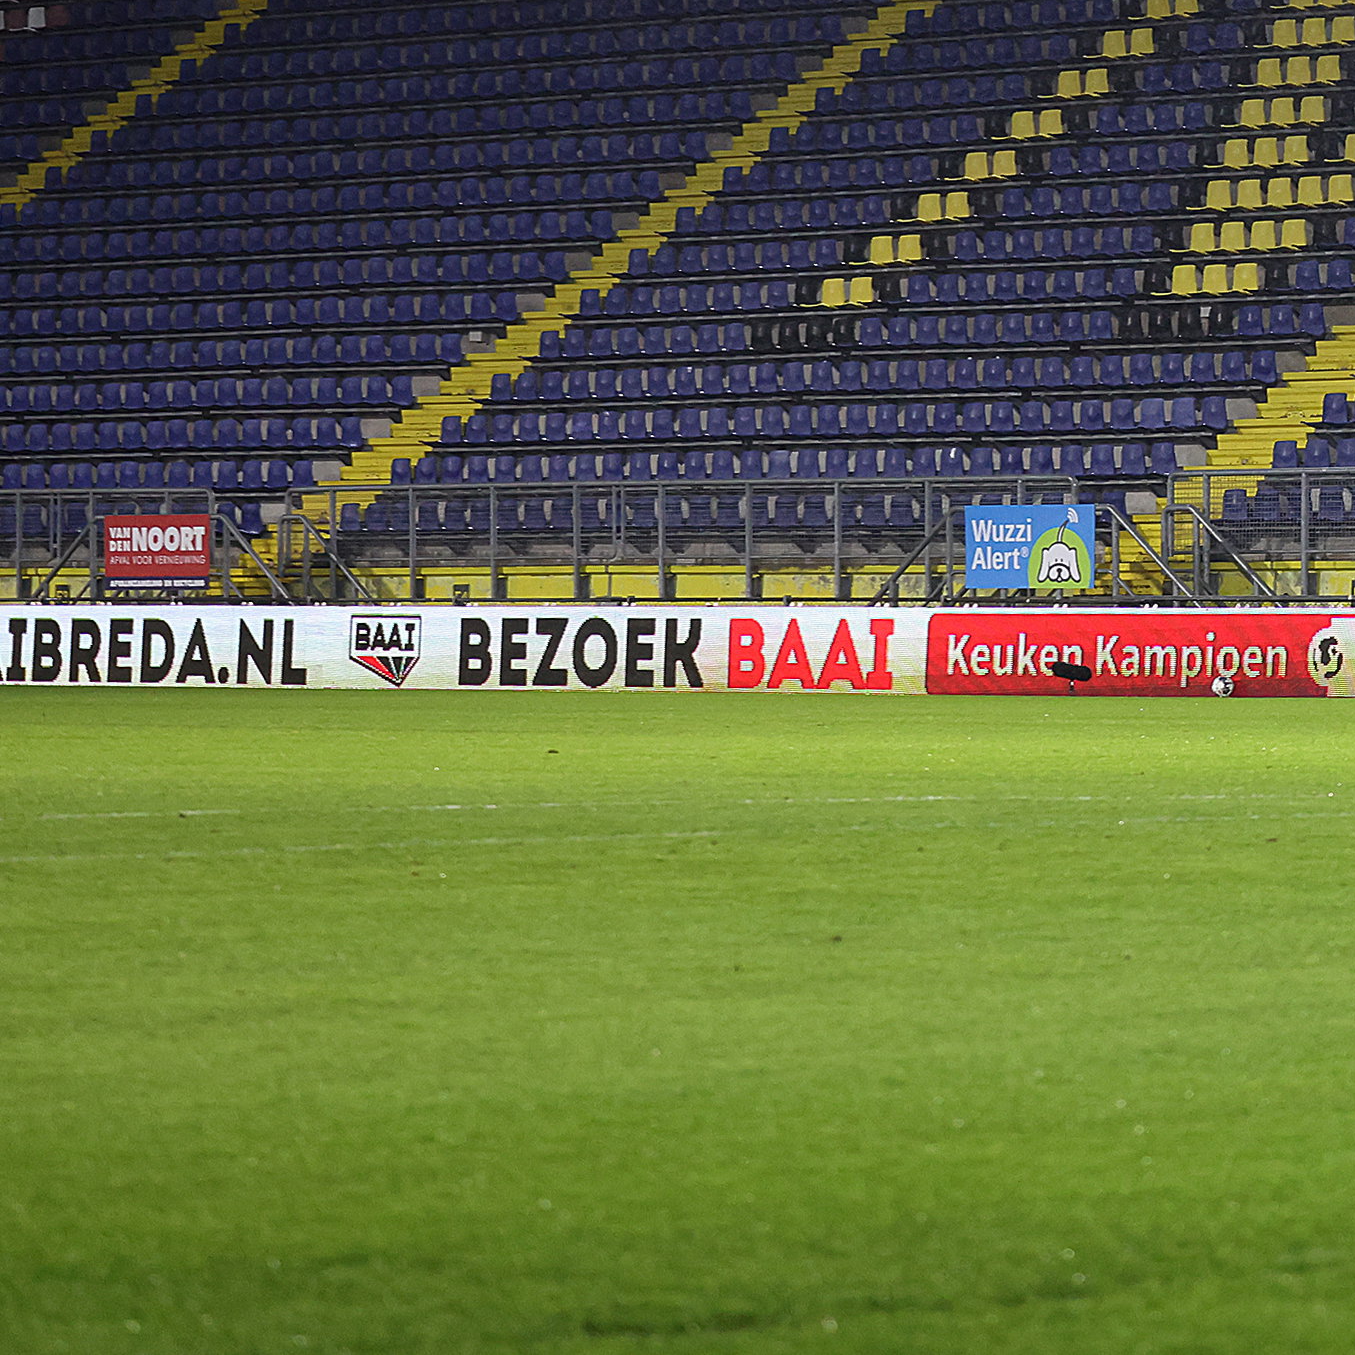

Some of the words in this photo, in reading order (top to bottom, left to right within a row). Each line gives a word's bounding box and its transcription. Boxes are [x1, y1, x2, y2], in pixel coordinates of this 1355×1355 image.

[109, 527, 131, 538] VAN
[132, 526, 205, 551] NOORT
[971, 518, 1032, 543] Wuzzi
[109, 541, 131, 552] DEN
[132, 556, 152, 565] VOOR
[354, 622, 415, 652] BAAI
[0, 618, 307, 685] IBREDA.NL
[458, 616, 703, 688] BEZOEK
[727, 618, 895, 690] BAAI
[946, 633, 1084, 677] Keuken
[1095, 633, 1287, 687] Kampioen
